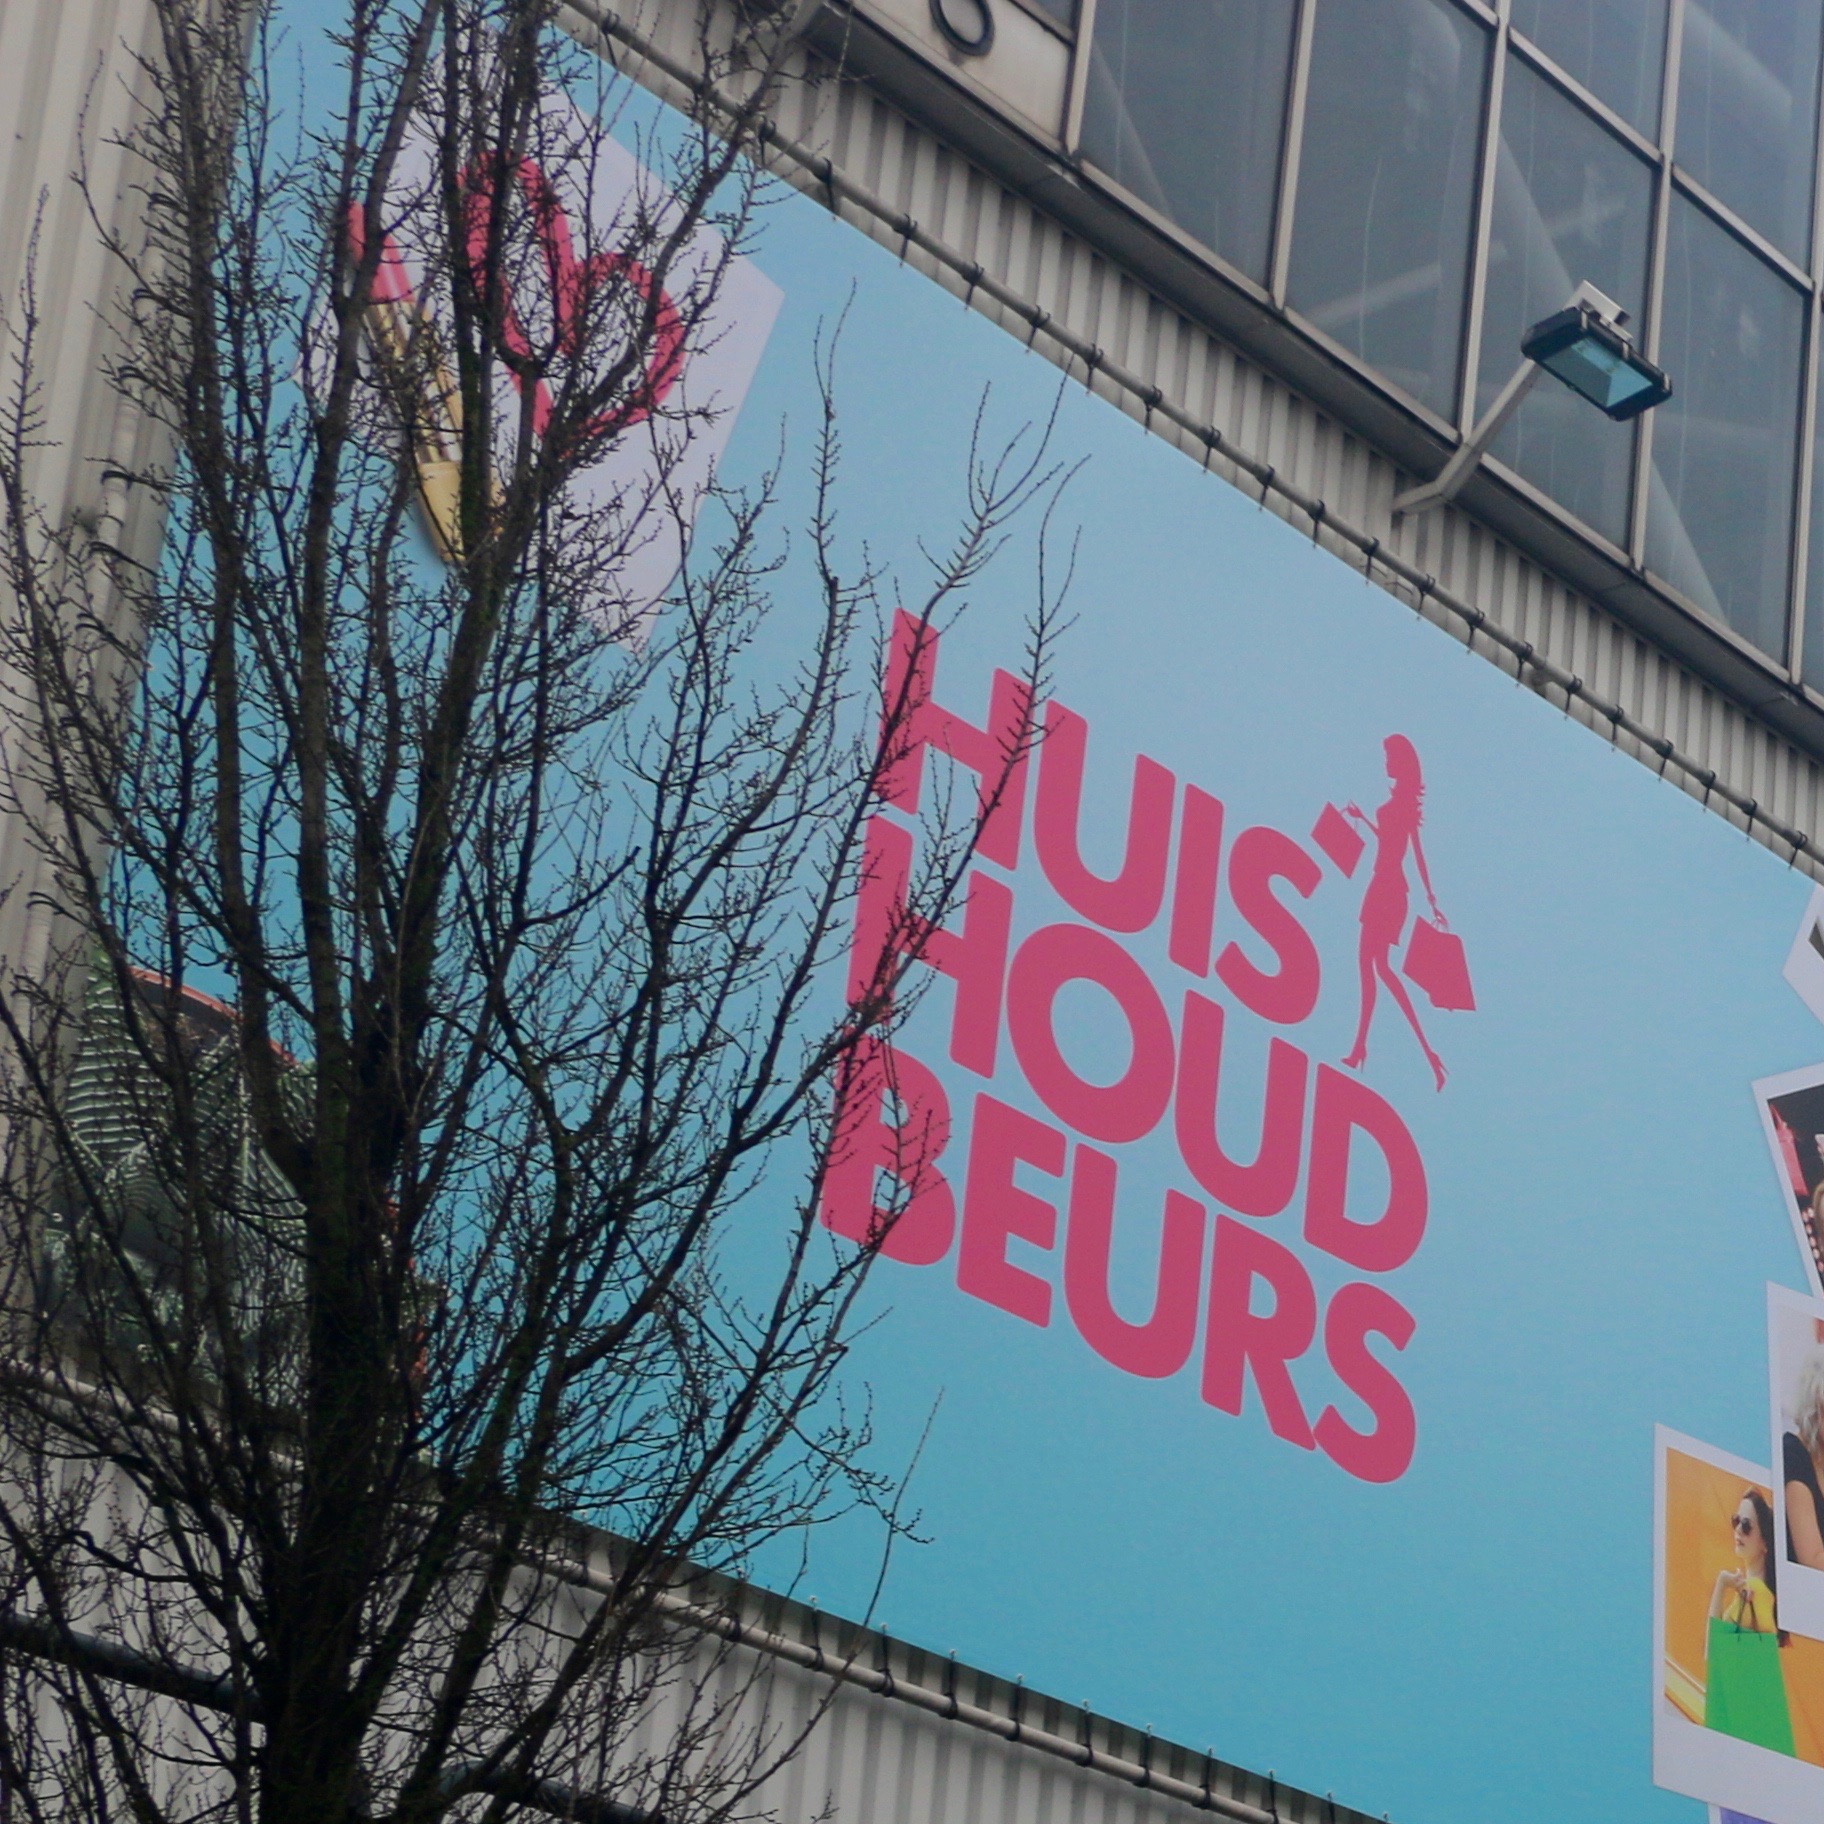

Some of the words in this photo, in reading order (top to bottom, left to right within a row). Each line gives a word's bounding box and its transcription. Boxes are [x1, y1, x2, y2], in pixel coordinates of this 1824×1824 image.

[845, 814, 1430, 1273] HOUD
[877, 606, 1324, 1024] HUIS
[819, 1024, 1417, 1484] BEURS
